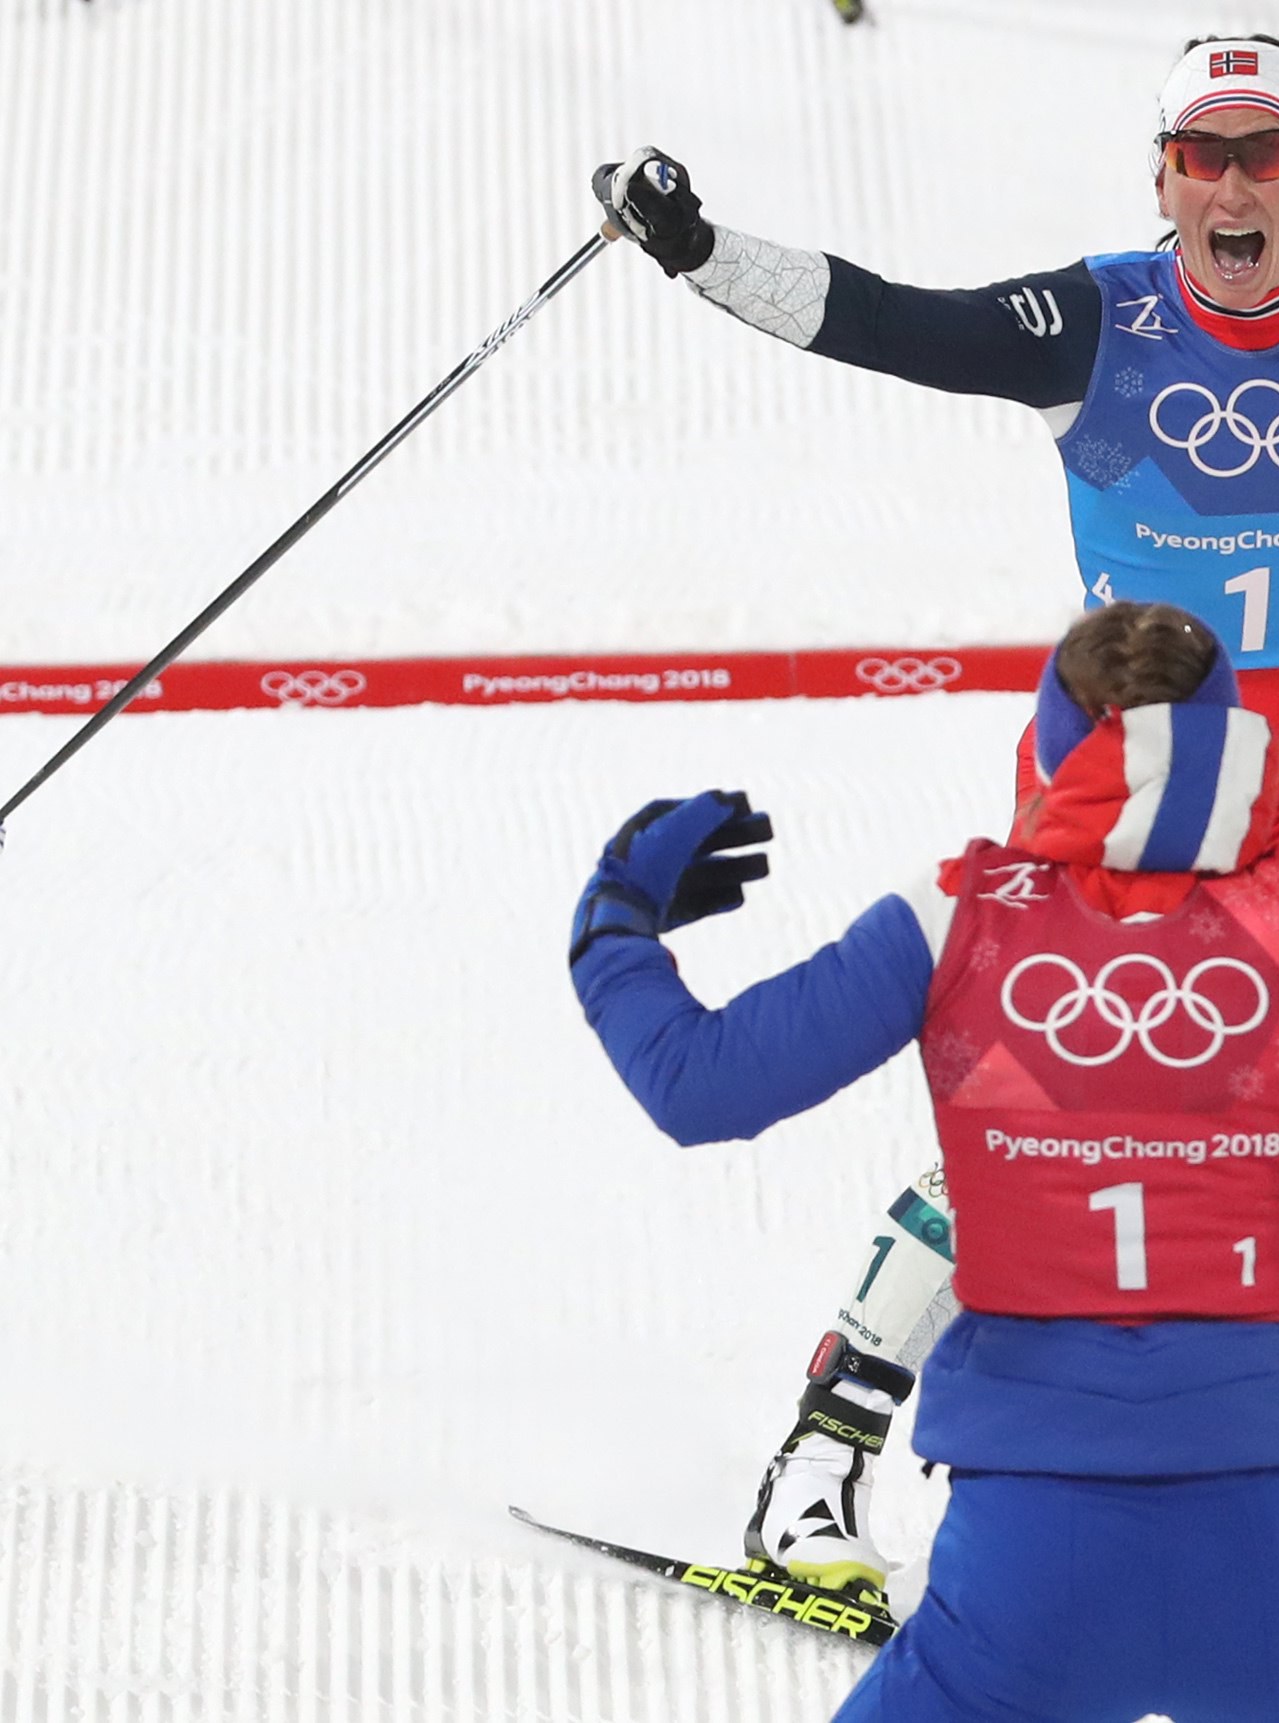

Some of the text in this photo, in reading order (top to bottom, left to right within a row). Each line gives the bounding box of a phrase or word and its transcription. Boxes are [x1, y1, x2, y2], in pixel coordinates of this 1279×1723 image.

[1224, 567, 1270, 653] 1
[95, 679, 163, 700] 208
[463, 668, 731, 697] PyeongChang 2018
[984, 1129, 1207, 1165] PyeongChang
[1088, 1181, 1148, 1290] 1
[856, 1235, 897, 1303] 1
[1232, 1236, 1256, 1287] 1
[859, 1326, 883, 1347] 2018
[680, 1564, 873, 1640] FISCHER
